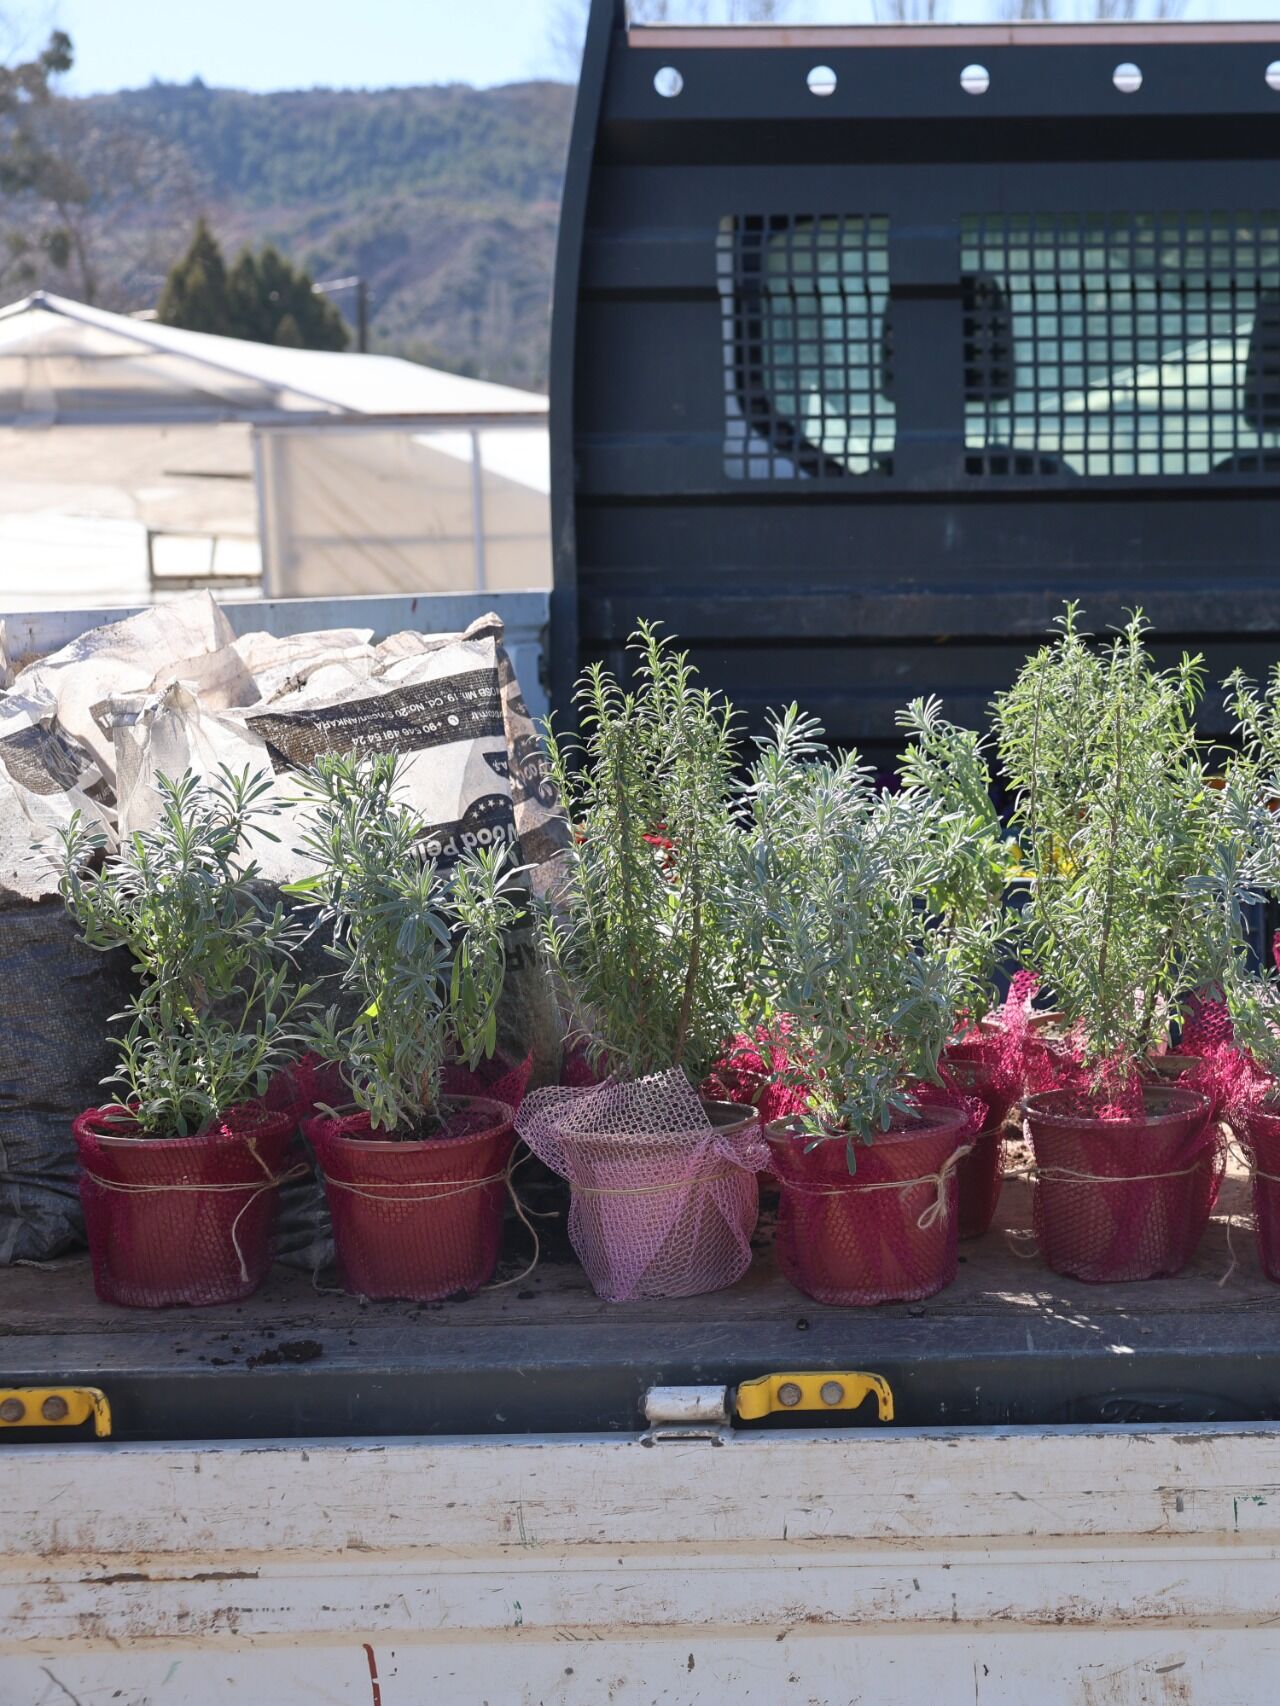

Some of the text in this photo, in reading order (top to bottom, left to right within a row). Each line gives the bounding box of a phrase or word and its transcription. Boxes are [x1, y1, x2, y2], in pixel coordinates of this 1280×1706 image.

[425, 697, 443, 708] Cd.
[395, 702, 423, 718] No:20
[401, 725, 420, 737] 546
[422, 720, 443, 734] +90
[351, 735, 365, 746] 24
[367, 731, 380, 743] 54
